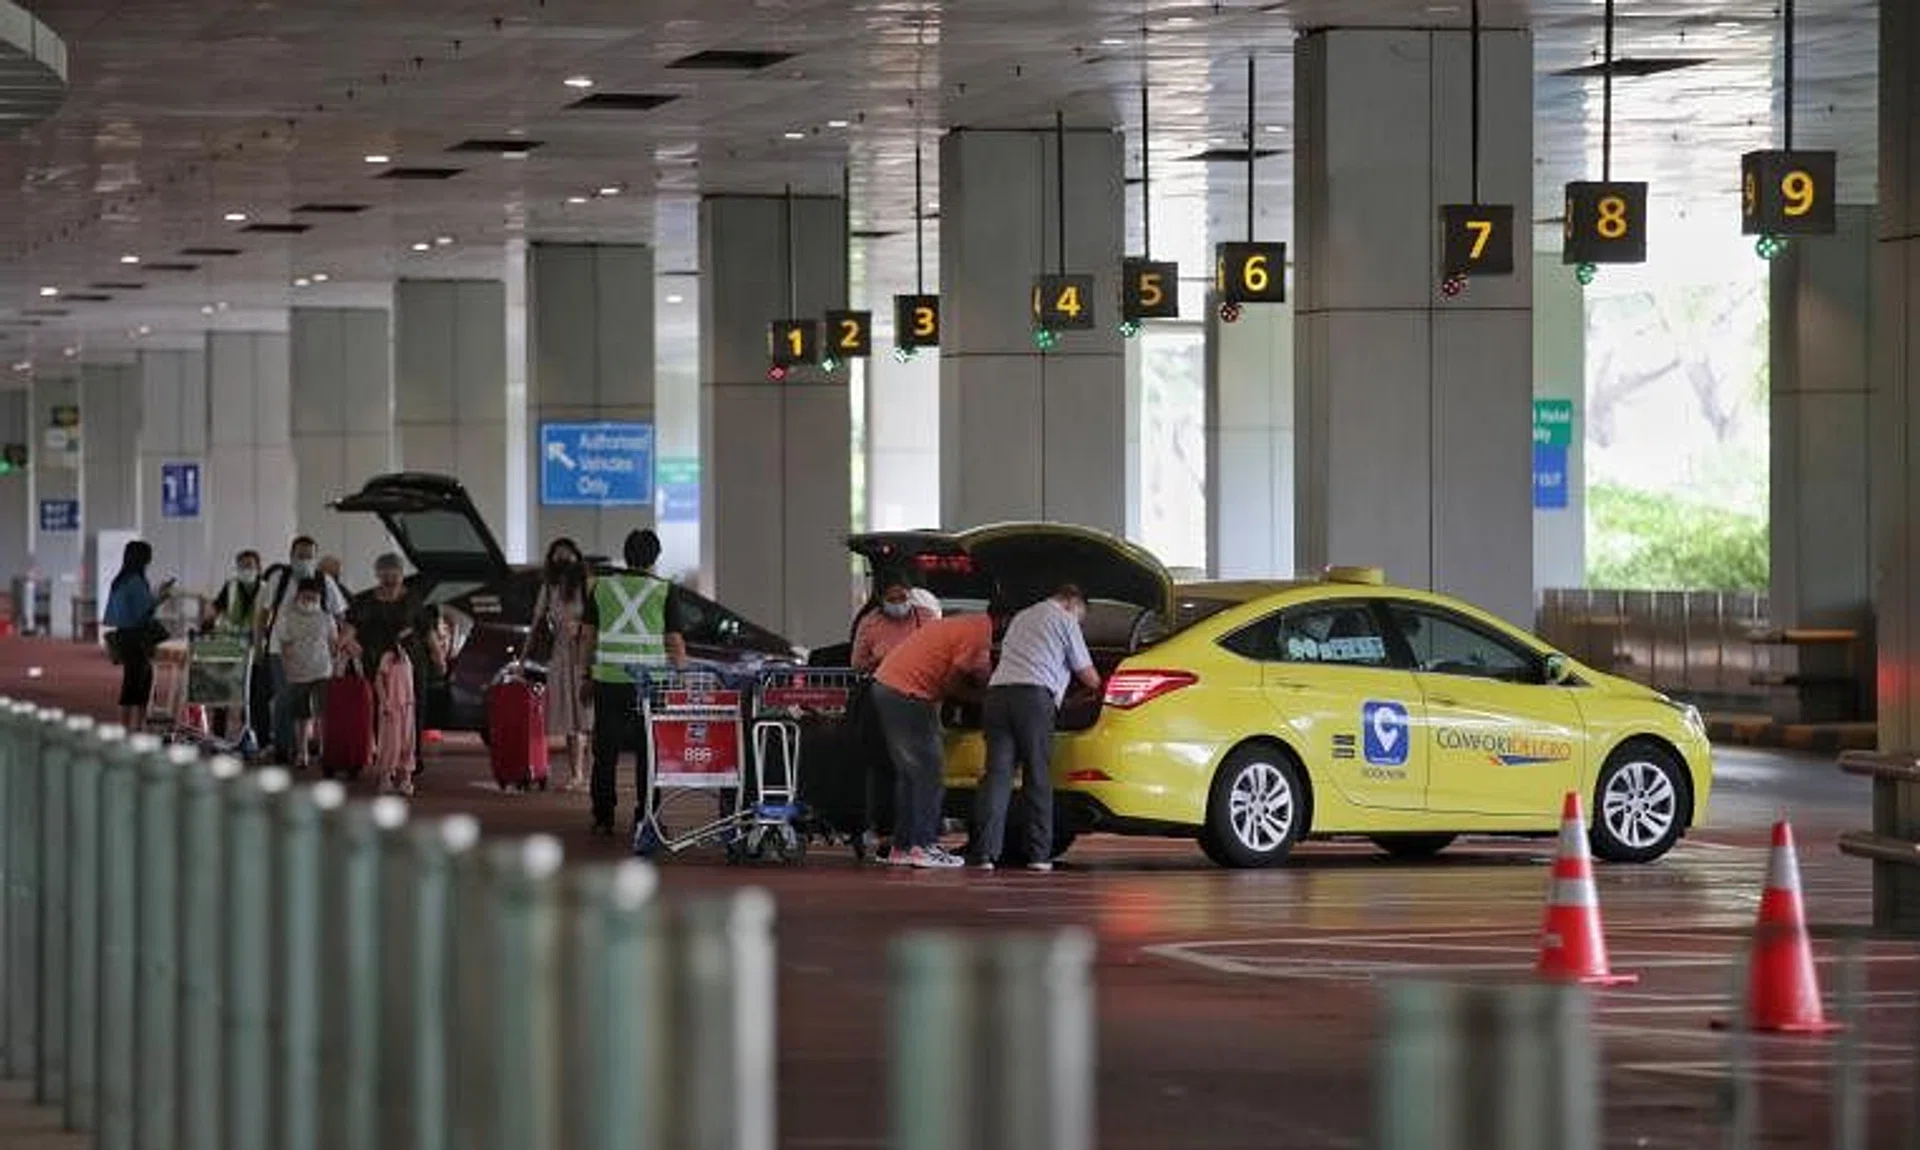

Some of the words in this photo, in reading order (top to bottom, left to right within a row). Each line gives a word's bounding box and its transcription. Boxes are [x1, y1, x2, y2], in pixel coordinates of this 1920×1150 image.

[1780, 170, 1814, 216] 9
[1597, 197, 1628, 238] 8
[1465, 220, 1492, 259] 7
[1243, 255, 1269, 291] 6
[1056, 286, 1081, 317] 4
[1138, 273, 1163, 306] 5
[840, 319, 860, 348] 2
[913, 307, 935, 336] 3
[787, 328, 804, 357] 1
[577, 475, 609, 497] Only
